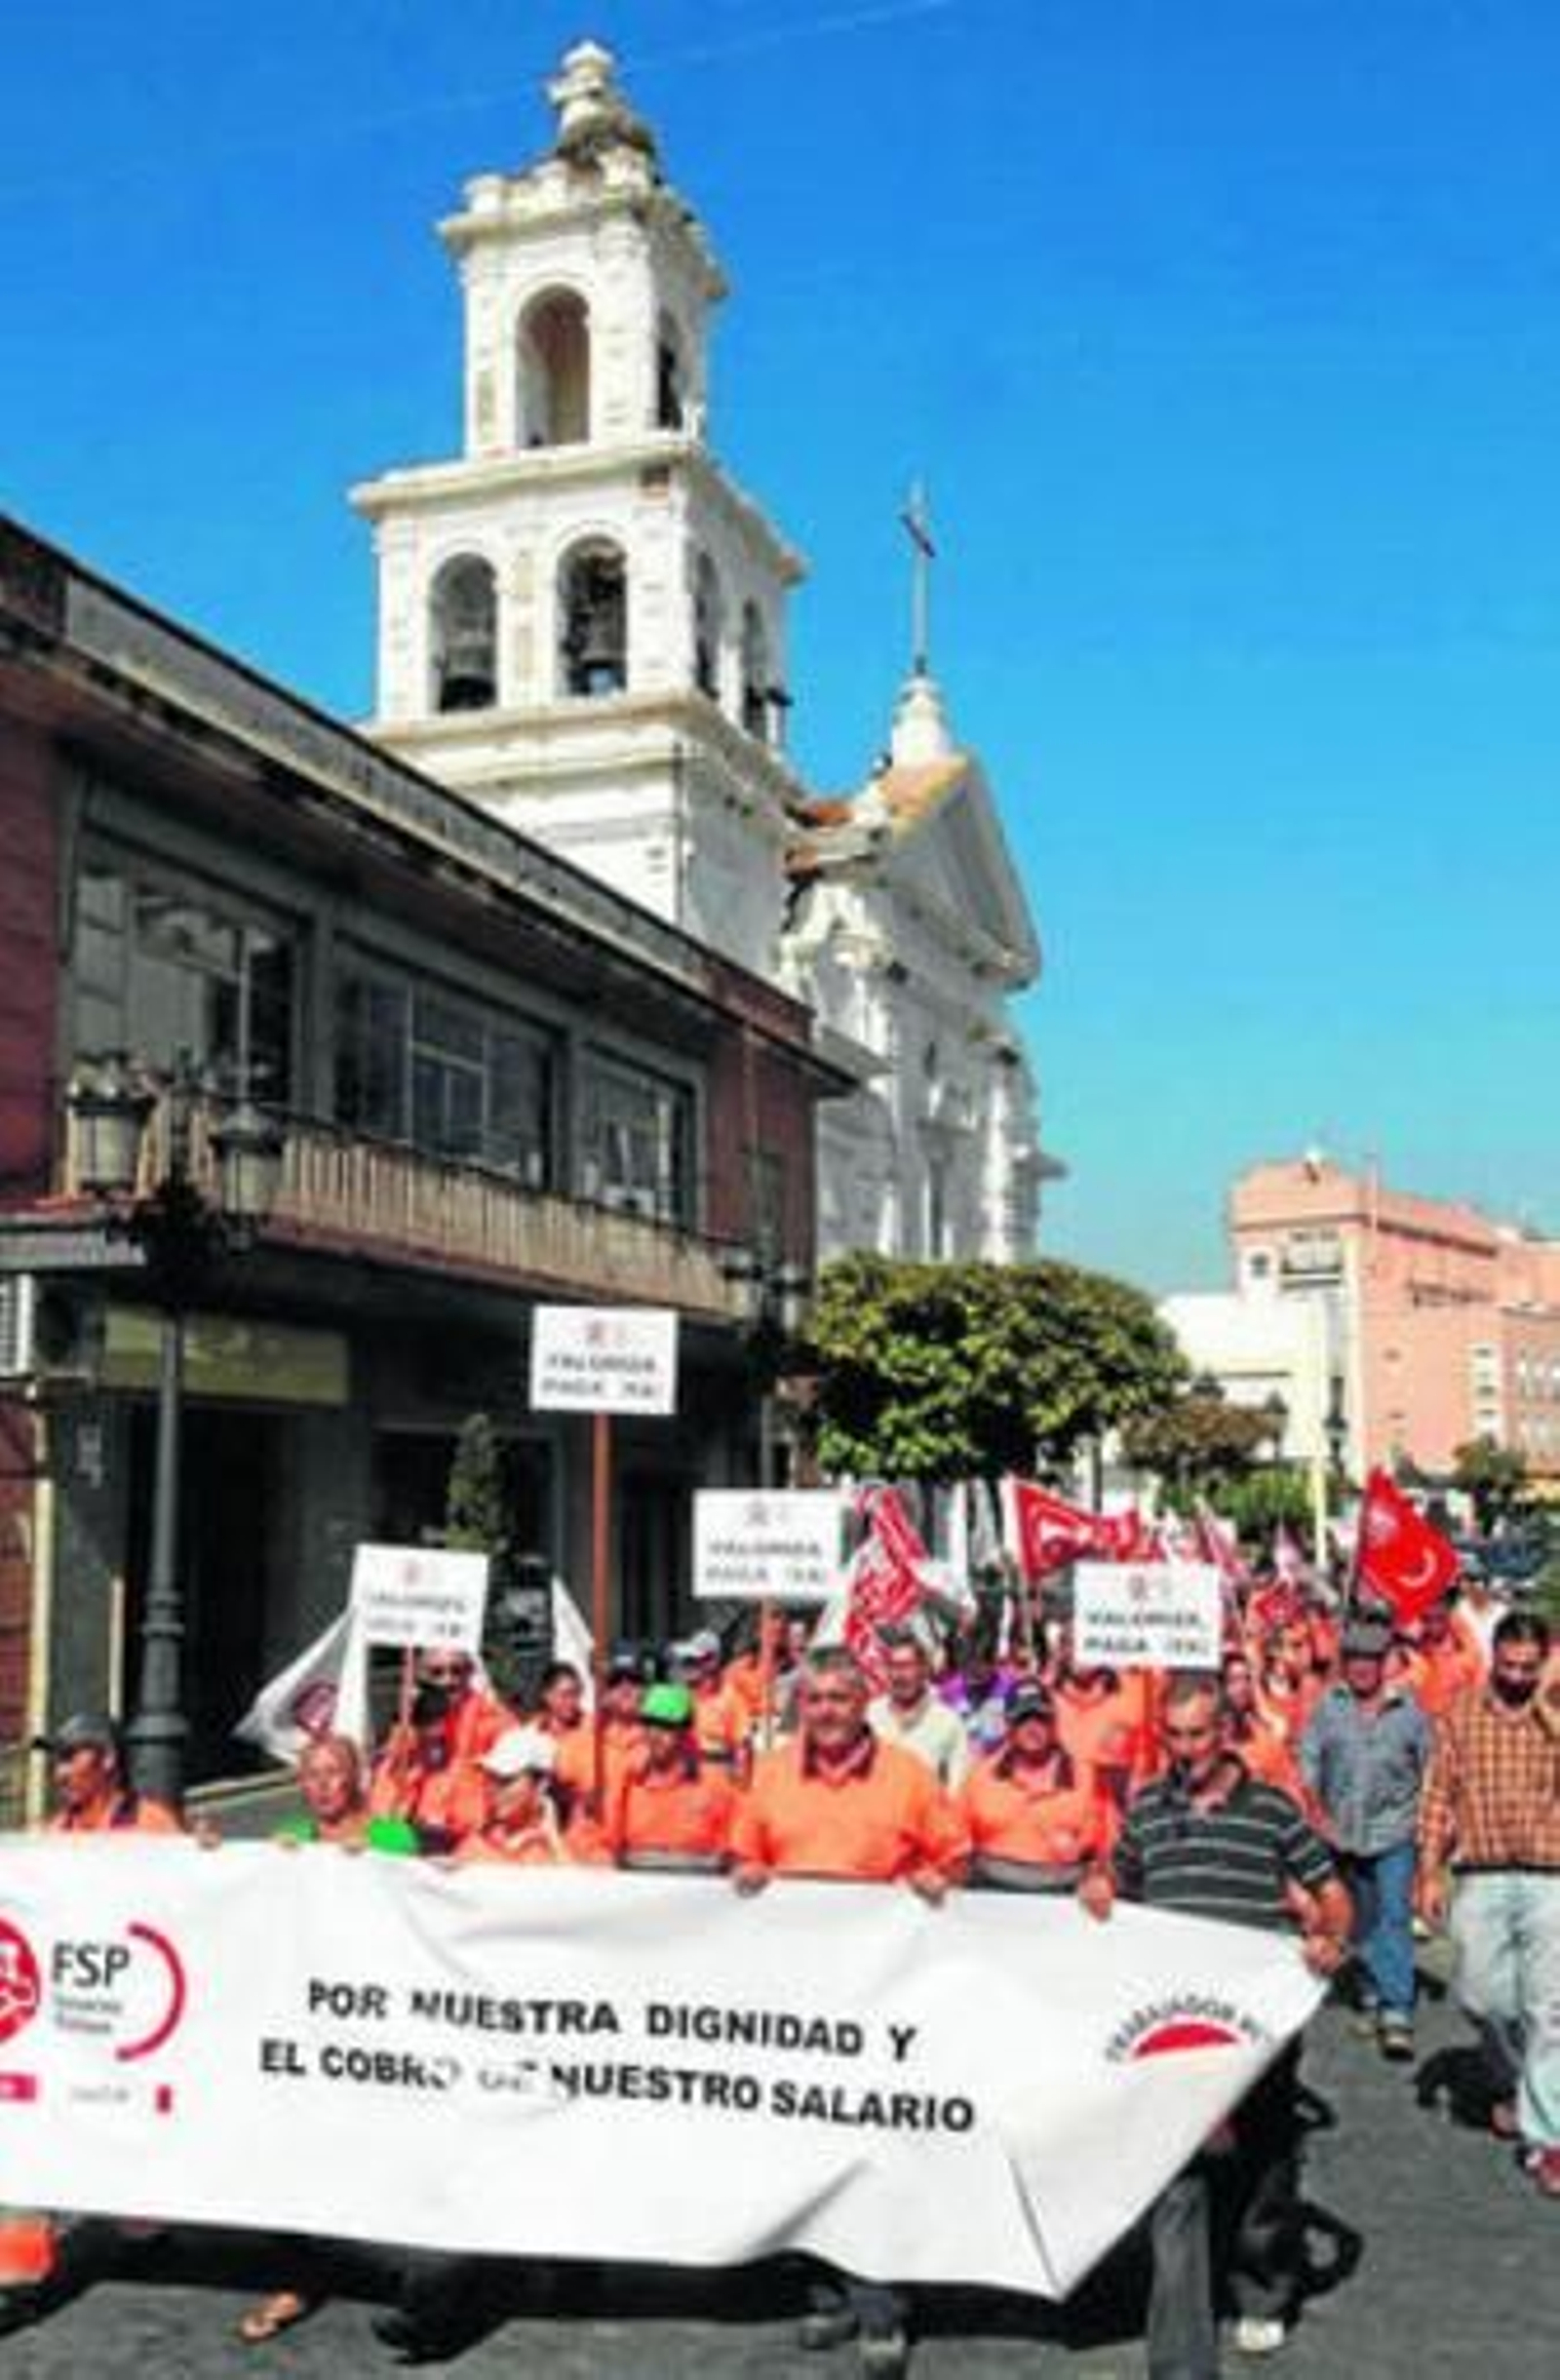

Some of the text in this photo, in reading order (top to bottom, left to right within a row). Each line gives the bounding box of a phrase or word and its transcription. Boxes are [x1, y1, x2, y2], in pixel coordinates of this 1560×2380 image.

[53, 1940, 130, 1989] FSP
[308, 1977, 917, 2062] POR NUESTRA DIGNIDAD Y
[259, 2037, 307, 2075] EL
[319, 2044, 463, 2090] COBRO
[549, 2063, 761, 2110] NUESTRO
[769, 2079, 975, 2133] SALARIO
